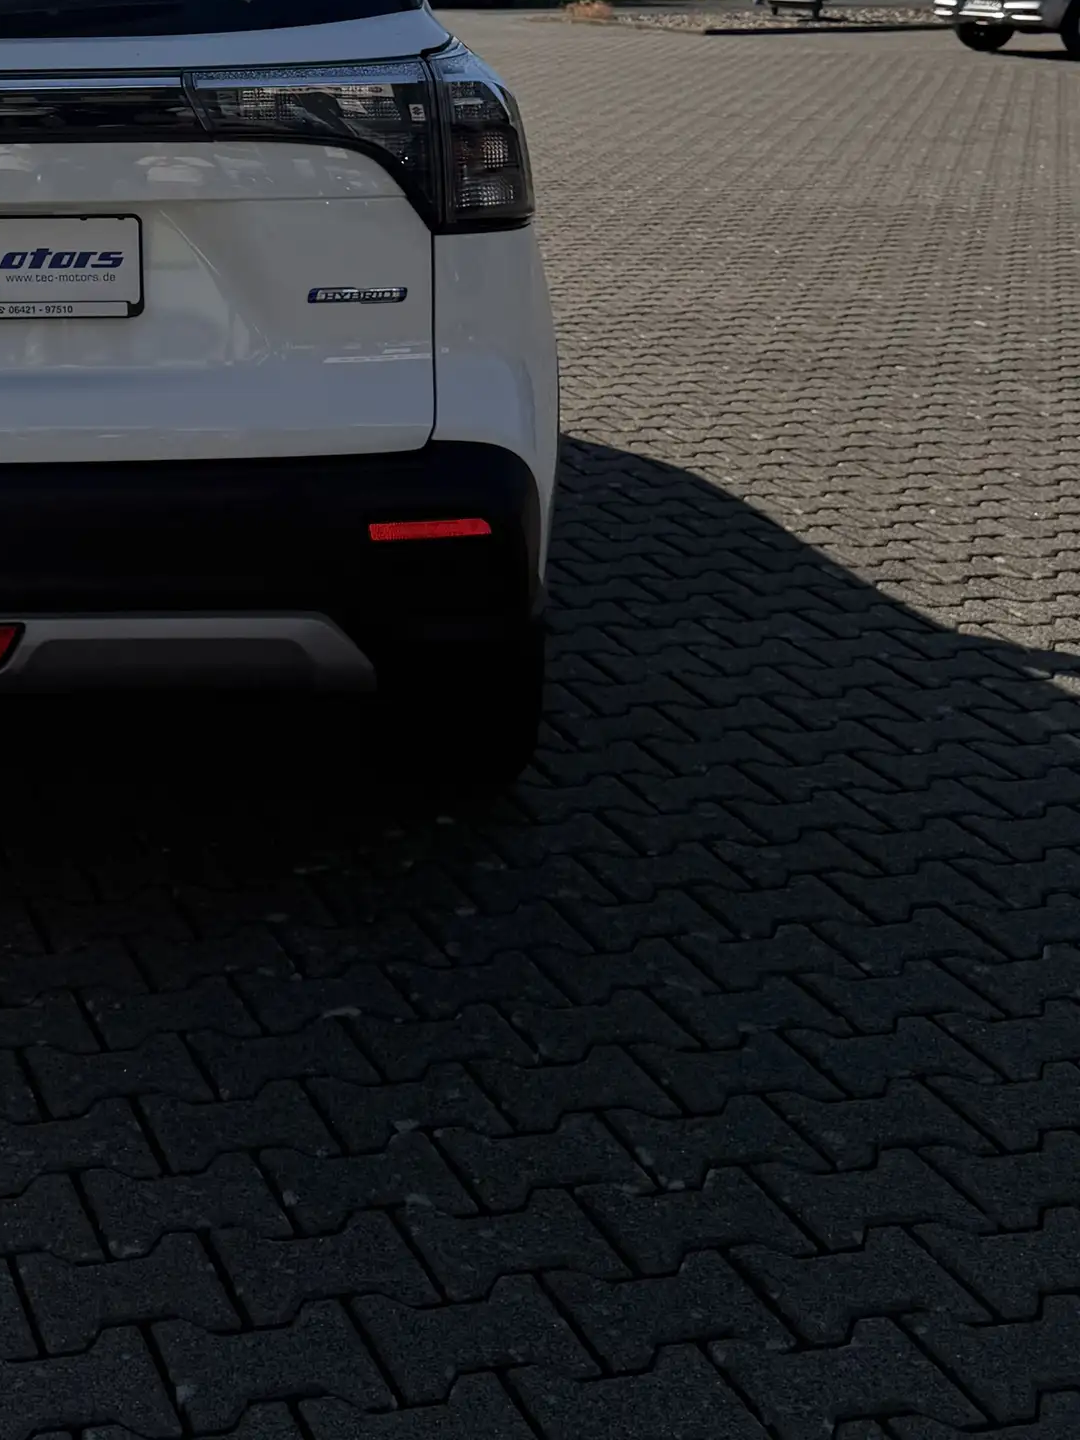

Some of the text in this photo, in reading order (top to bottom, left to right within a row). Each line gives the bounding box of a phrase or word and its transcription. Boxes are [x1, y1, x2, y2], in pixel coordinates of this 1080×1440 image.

[5, 271, 117, 283] www.tec-motors.de
[322, 289, 395, 301] HYBRID
[8, 305, 36, 315] 06421
[44, 305, 73, 314] 97510
